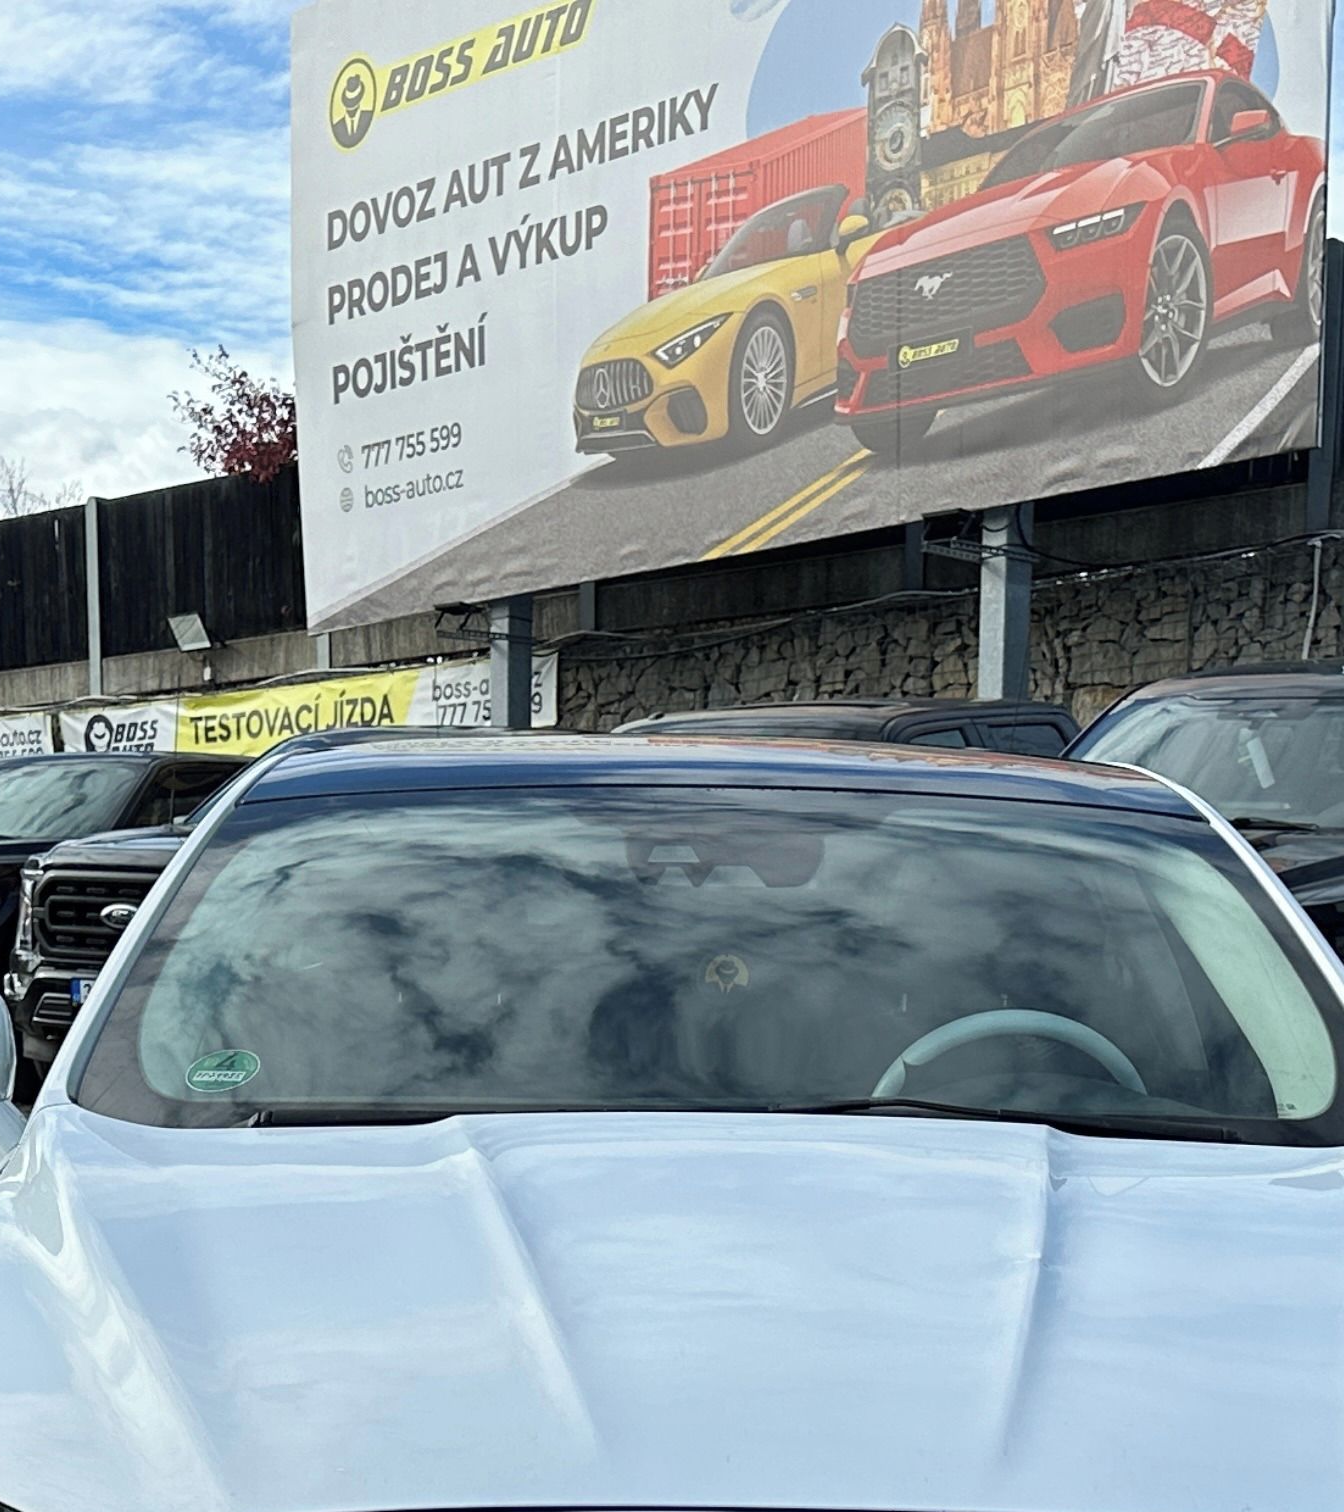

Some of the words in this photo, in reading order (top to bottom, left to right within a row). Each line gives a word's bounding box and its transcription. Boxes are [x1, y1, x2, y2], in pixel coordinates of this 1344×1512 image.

[380, 38, 476, 112] BOSS
[480, 0, 593, 76] AUTO
[327, 177, 436, 251] DOVOZ
[443, 153, 511, 214] AUT
[518, 145, 541, 190] Z
[547, 83, 719, 181] AMERIKY
[327, 251, 449, 325] PRODEJ
[455, 243, 481, 288] A
[488, 204, 608, 276] VÝKUP
[332, 312, 489, 405] POJIŠTĚNÍ
[361, 439, 391, 469] 777
[395, 430, 426, 461] 755
[430, 422, 462, 453] 599
[364, 469, 464, 509] boss-auto.cz
[114, 719, 159, 743] BOSS
[190, 693, 322, 745] TESTOVACÍ
[326, 689, 395, 730] JÍZDA
